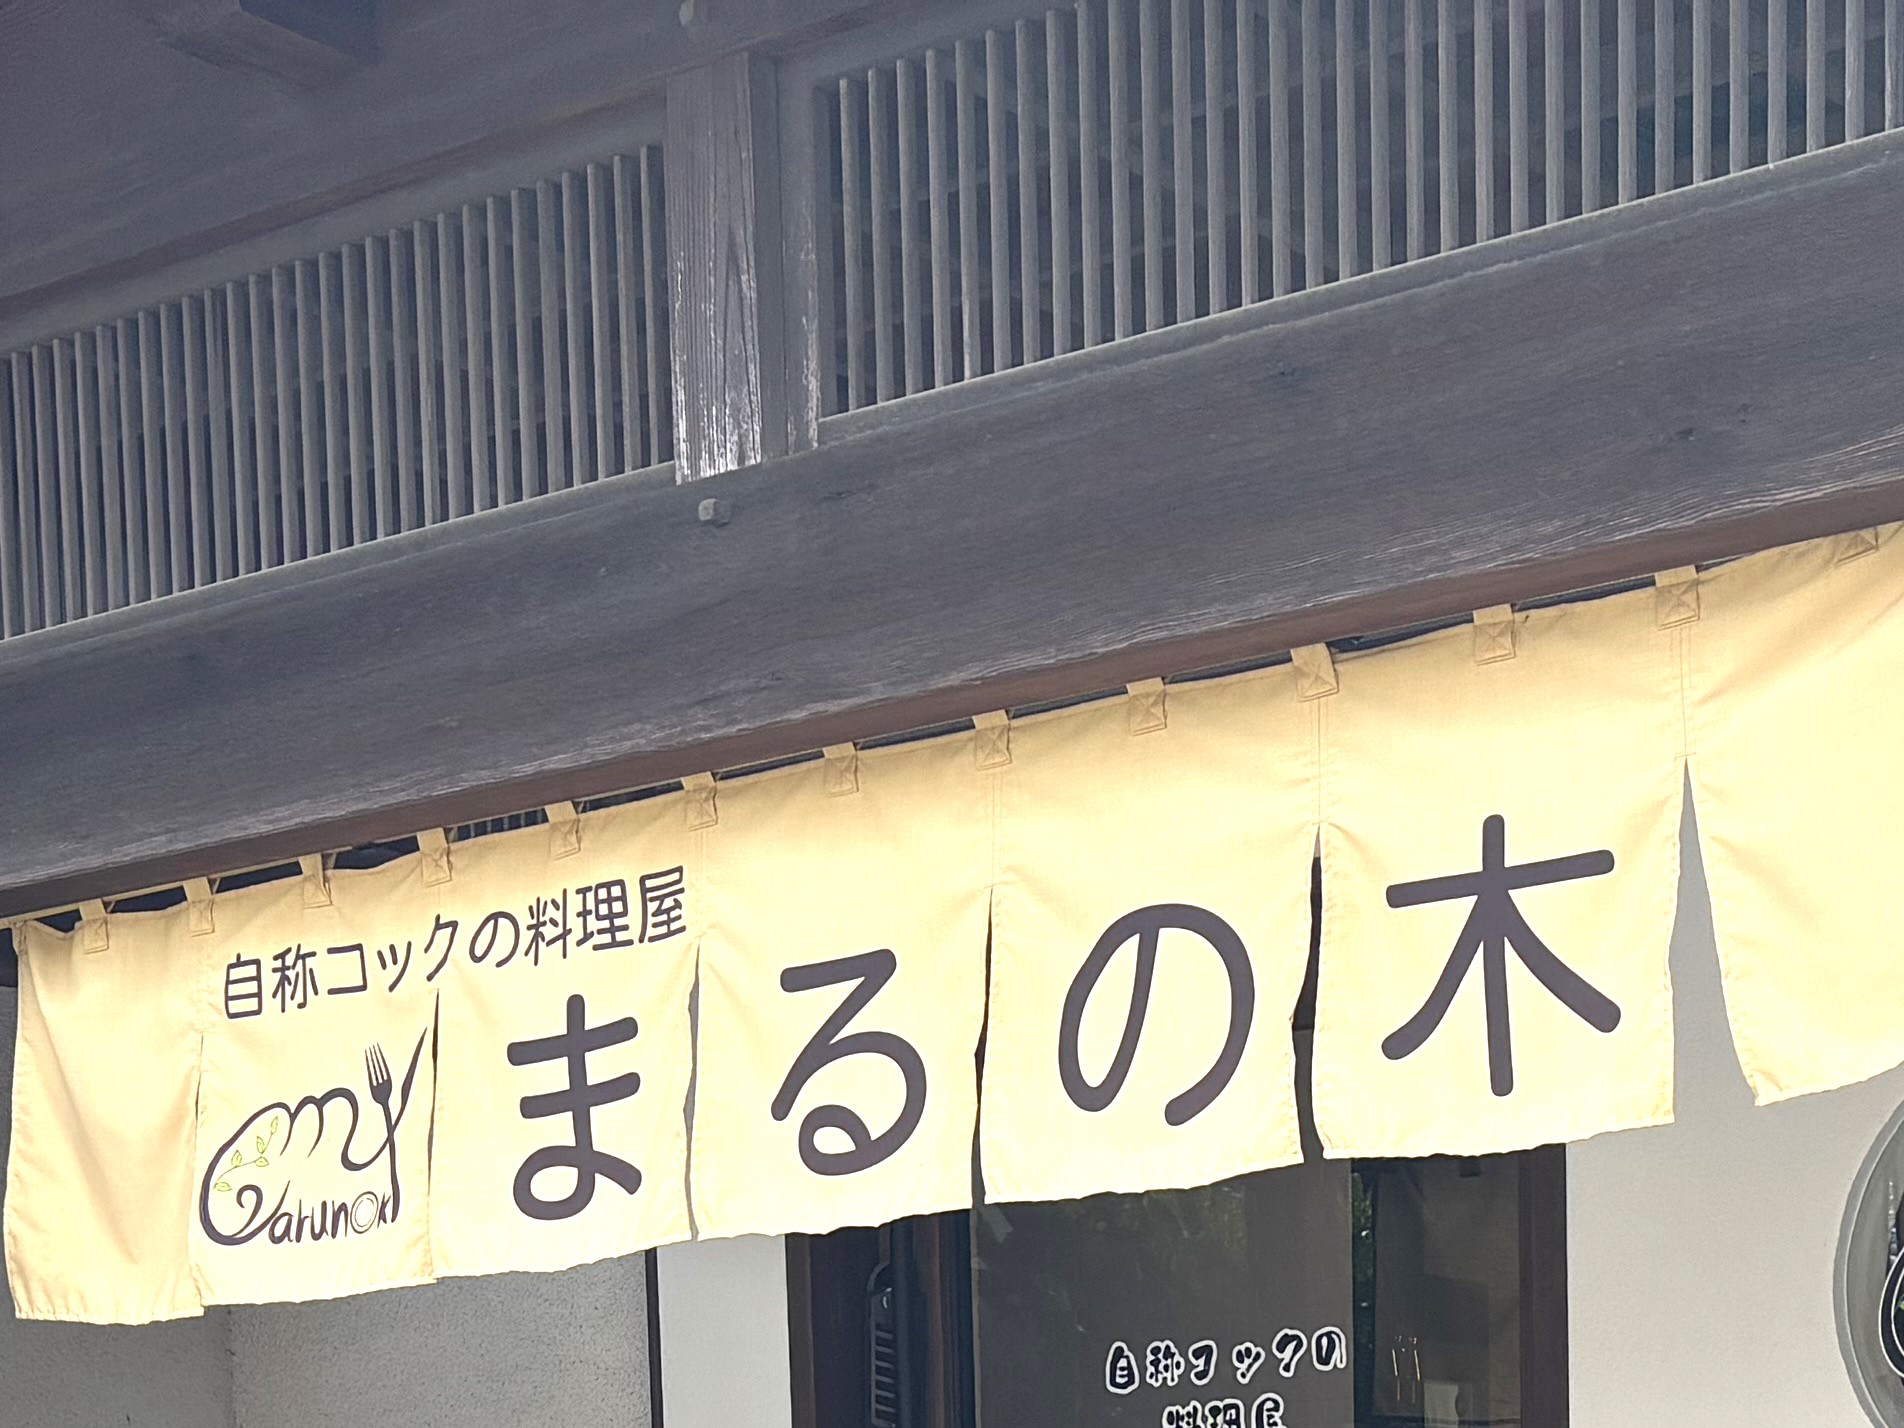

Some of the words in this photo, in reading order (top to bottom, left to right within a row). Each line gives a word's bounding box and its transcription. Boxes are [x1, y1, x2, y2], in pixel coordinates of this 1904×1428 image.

[224, 865, 686, 1019] 自称コックの料理屋
[507, 813, 1622, 1222] まるの木
[1106, 1326, 1346, 1394] 自称コックの
